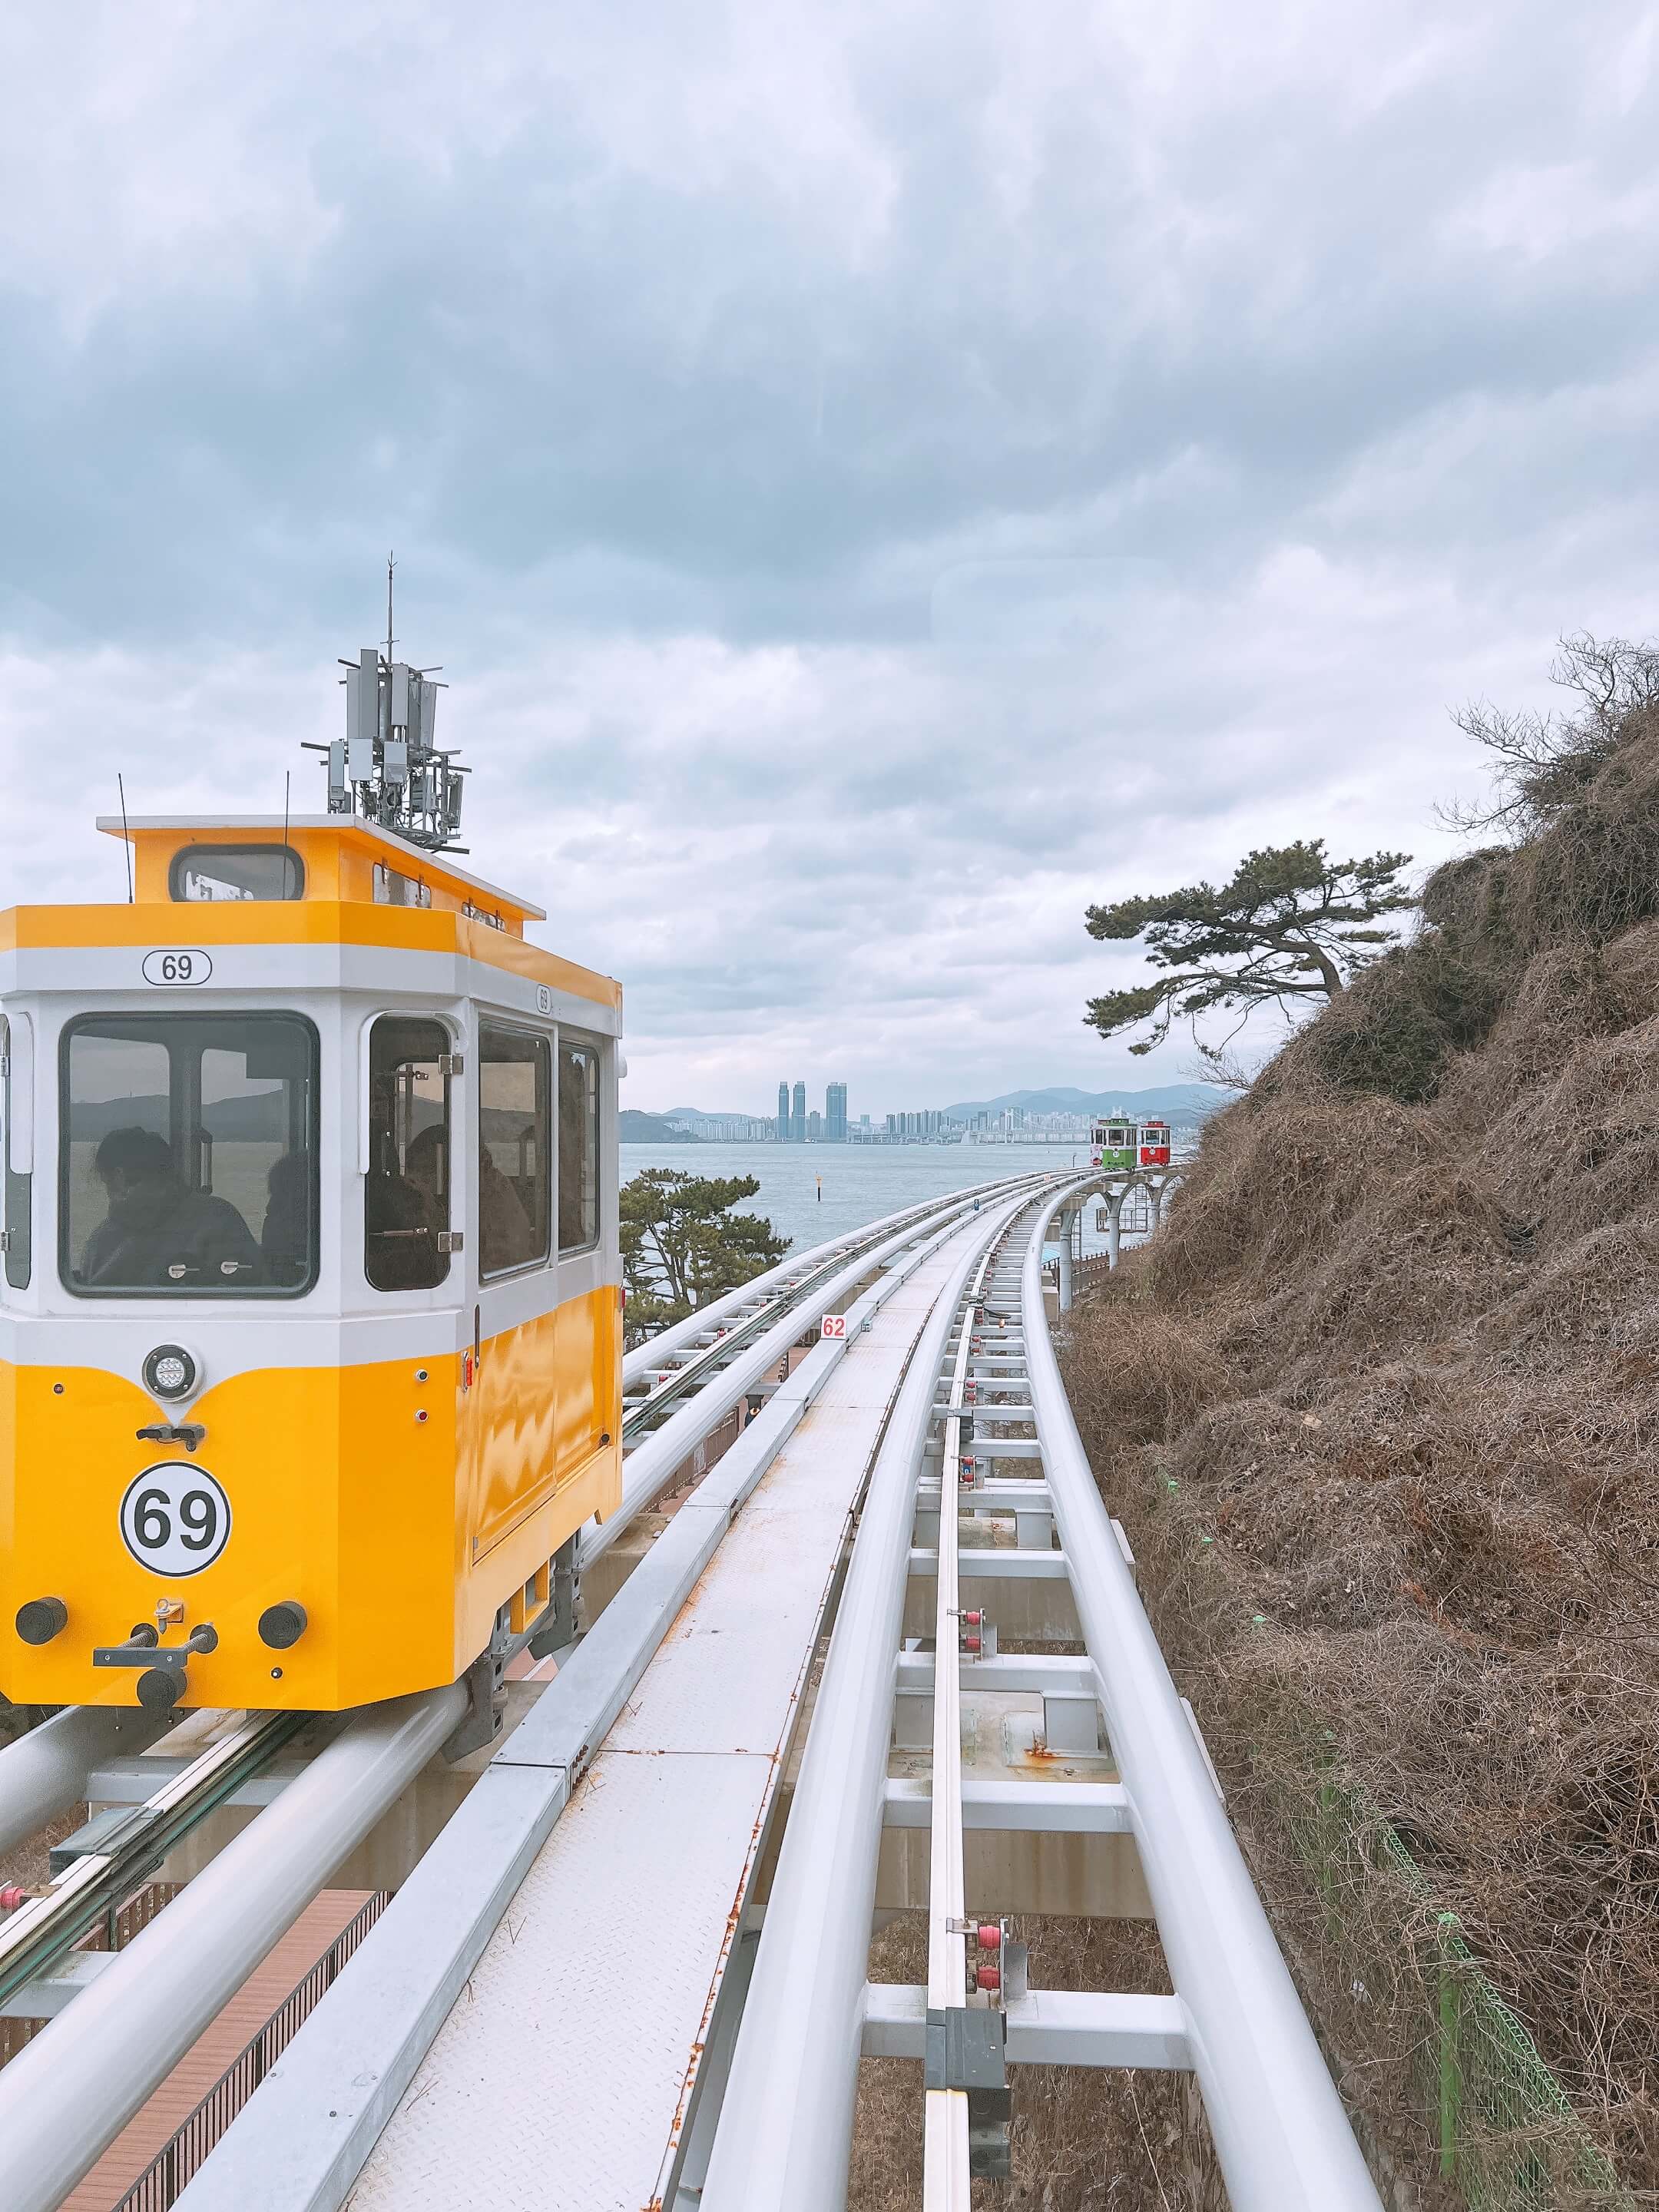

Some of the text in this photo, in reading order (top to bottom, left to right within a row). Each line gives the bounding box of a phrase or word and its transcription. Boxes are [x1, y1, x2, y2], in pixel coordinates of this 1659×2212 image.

[162, 955, 192, 980] 69
[540, 988, 548, 1009] 69
[824, 1318, 844, 1336] 62
[134, 1488, 217, 1550] 69
